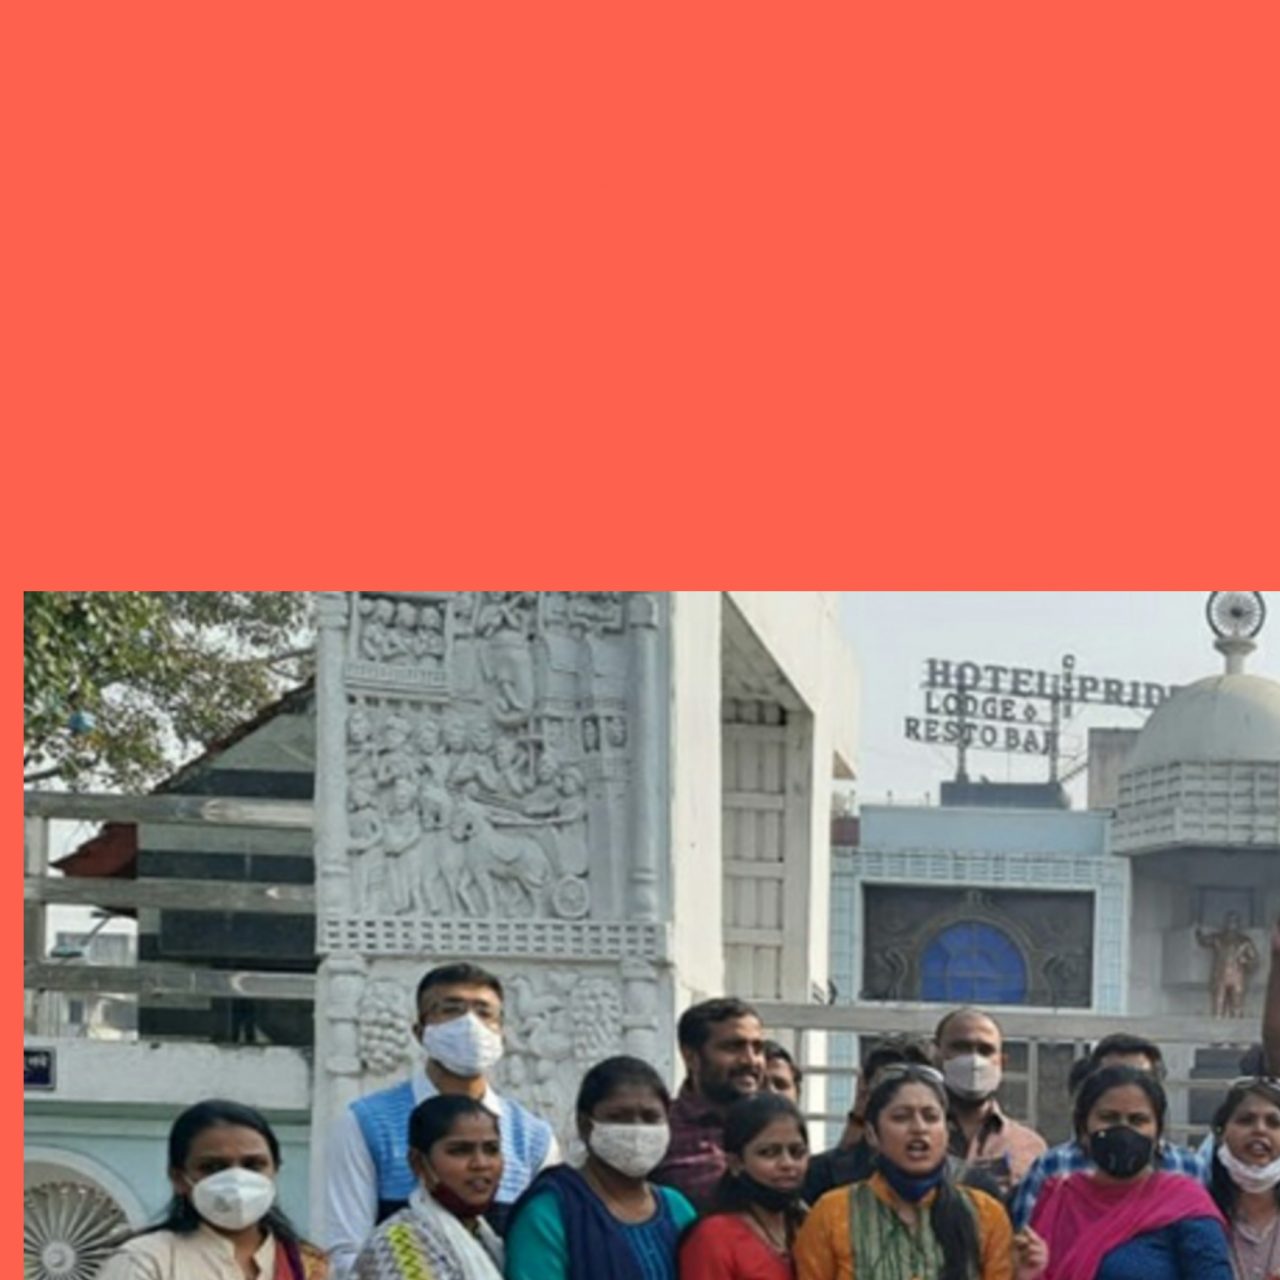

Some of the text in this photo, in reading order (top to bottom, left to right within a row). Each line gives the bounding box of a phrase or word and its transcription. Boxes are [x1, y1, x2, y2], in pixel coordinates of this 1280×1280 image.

[923, 657, 1061, 700] HOTEL
[925, 691, 1017, 721] LODGE
[904, 716, 998, 748] RESTO
